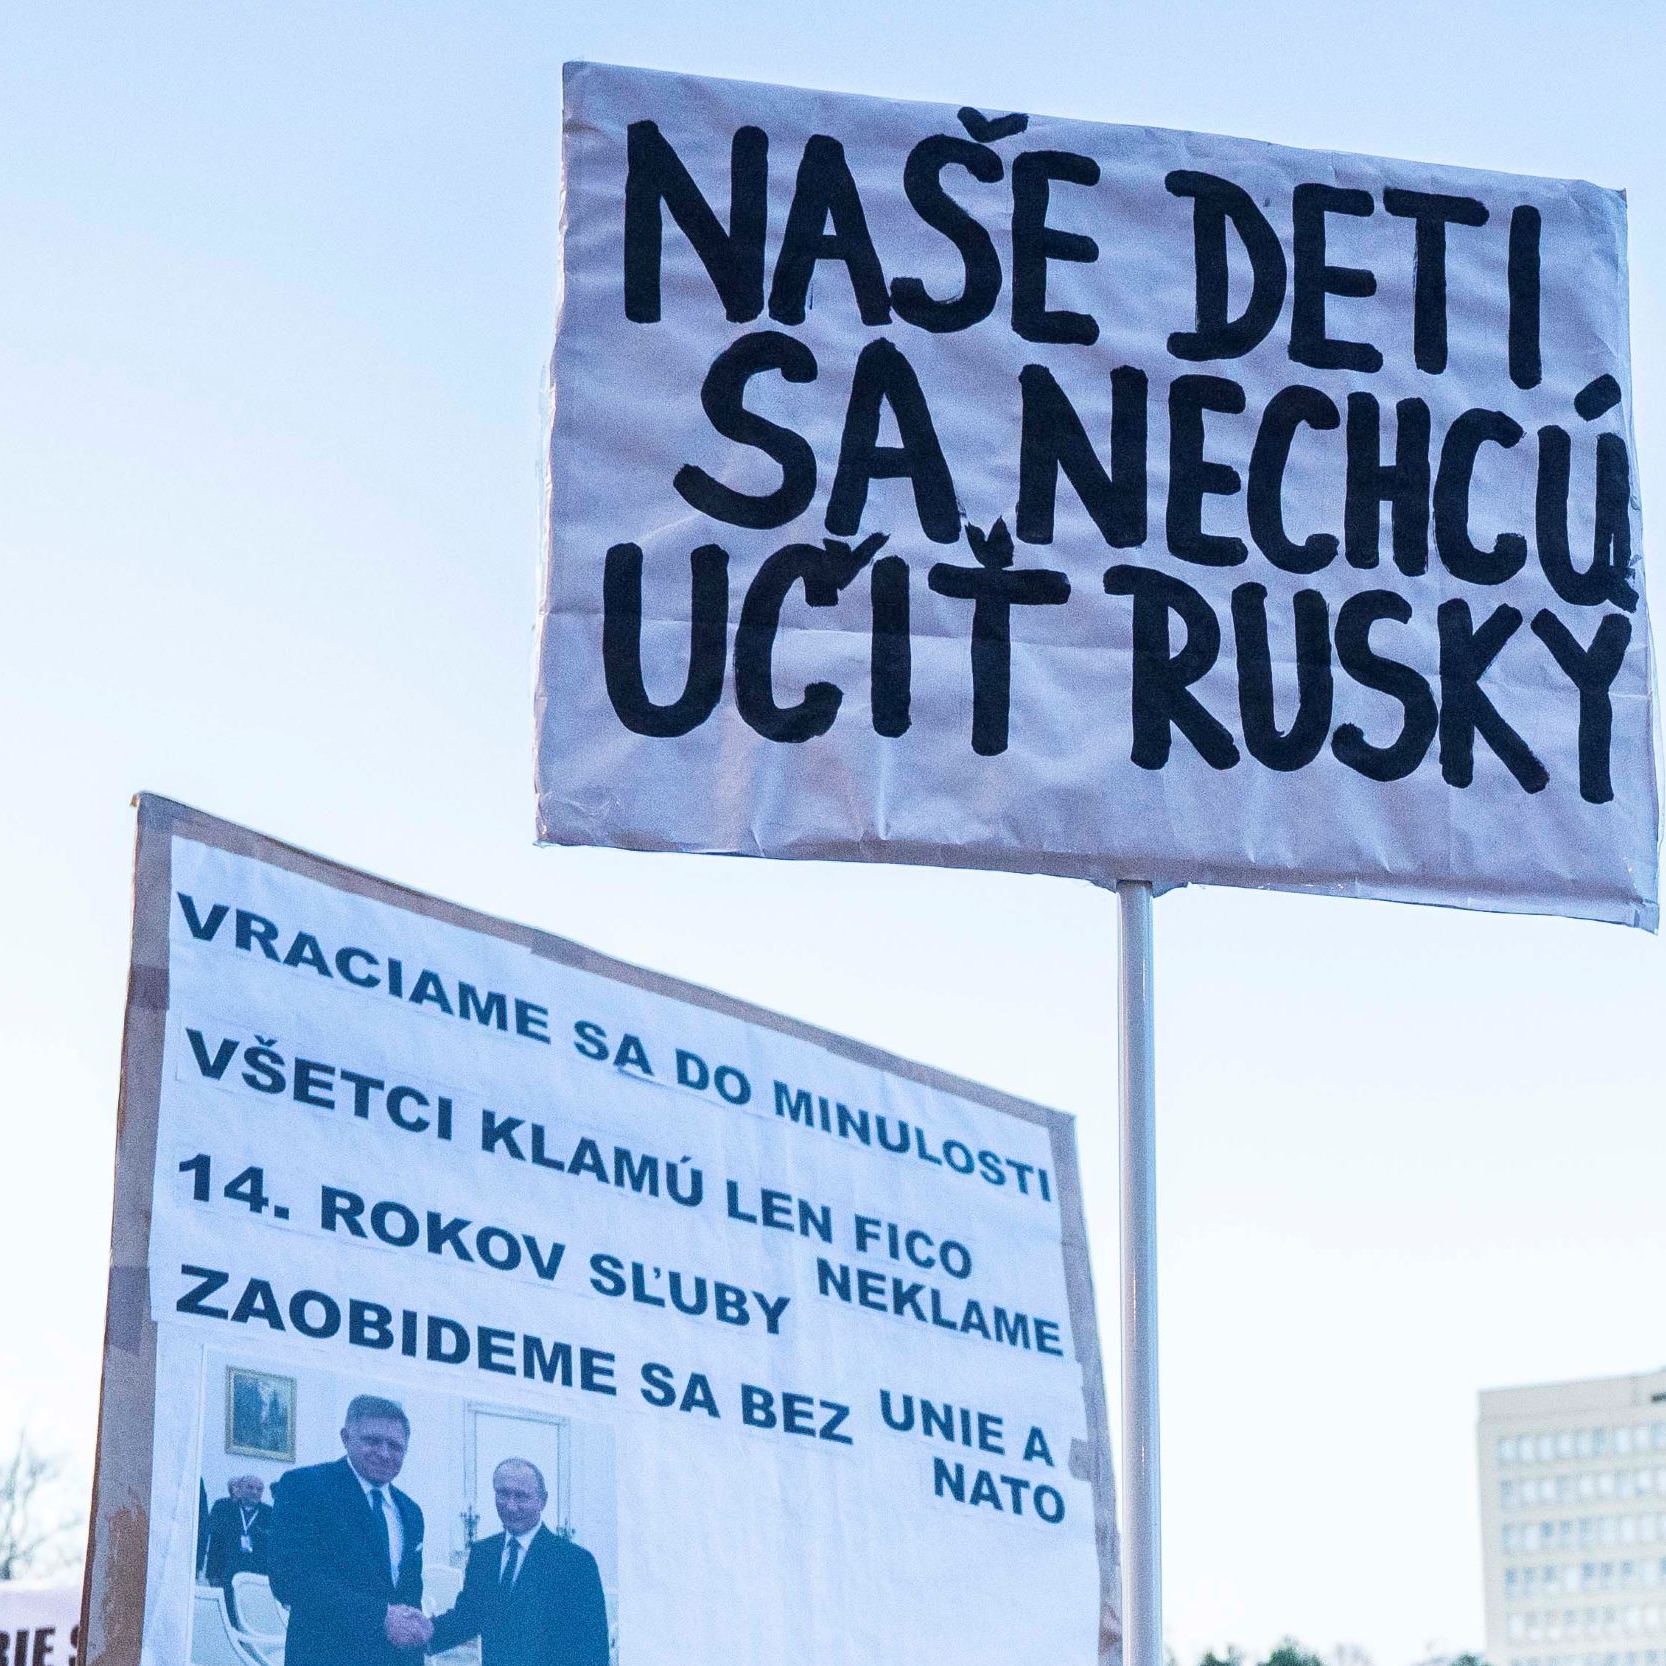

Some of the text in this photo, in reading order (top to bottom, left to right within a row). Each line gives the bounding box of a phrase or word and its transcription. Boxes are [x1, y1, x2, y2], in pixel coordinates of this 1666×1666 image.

[623, 107, 1542, 390] NAŠE DETI
[673, 331, 1639, 612] SA NECHCÚ
[602, 518, 1631, 805] UČIŤ RUSKY
[176, 892, 1052, 1201] VRACIAME SA DO MINULOSTI
[186, 1027, 972, 1280] VŠETCI KLAMÚ LEN FICO
[176, 1264, 1054, 1467] ZAOBIDEME SA BEZ UNIE A
[177, 1152, 791, 1335] 14. ROKOV SĽUBY
[817, 1259, 1063, 1356] NEKLAME
[932, 1456, 1065, 1525] NATO
